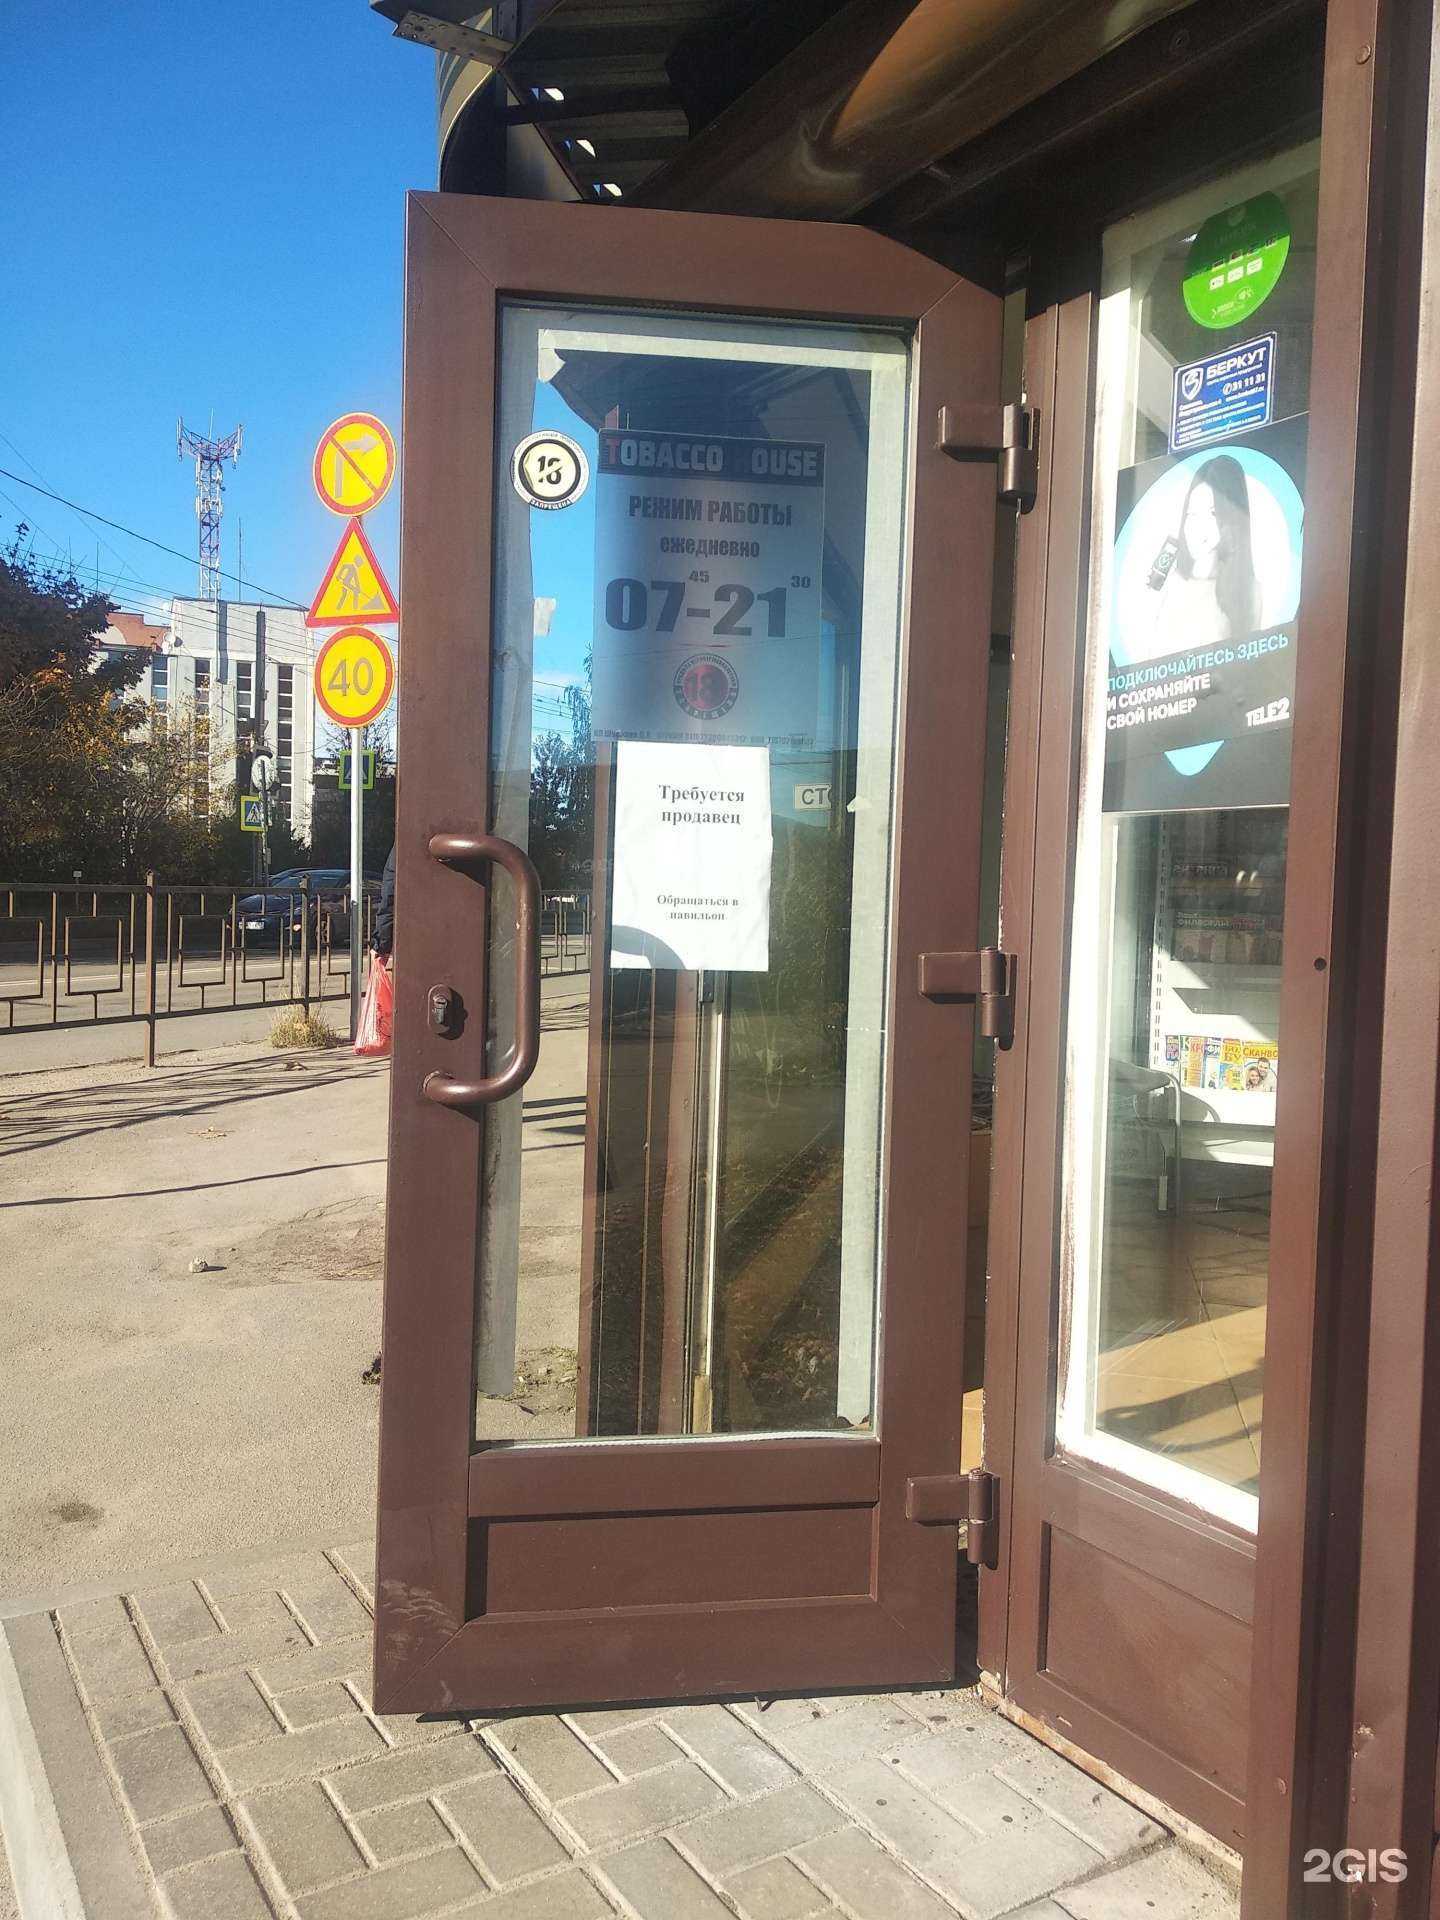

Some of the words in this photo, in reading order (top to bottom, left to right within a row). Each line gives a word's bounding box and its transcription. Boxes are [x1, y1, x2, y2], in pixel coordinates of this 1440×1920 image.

[1206, 347, 1267, 379] БЕРКУТ
[605, 438, 724, 473] TOBACCO
[629, 495, 701, 522] РЕЖИМ
[707, 500, 792, 527] РАБОТЫ
[660, 537, 760, 558] ежедневно
[791, 575, 811, 589] 30
[327, 657, 373, 697] 40
[1107, 649, 1236, 692] ПОДКЛЮЧАЙТЕСЬ
[1237, 633, 1289, 661] ЗДЕСЬ
[1107, 695, 1117, 711] И
[1118, 673, 1211, 708] СОХРАНЯЙТЕ
[1106, 703, 1146, 730] СВОЙ
[1147, 697, 1198, 722] НОМЕР
[1245, 696, 1290, 727] TELE2
[658, 784, 744, 804] Требуется
[662, 811, 741, 825] продавец
[657, 894, 728, 908] Обращаться
[732, 898, 739, 906] в
[670, 912, 725, 920] павильон
